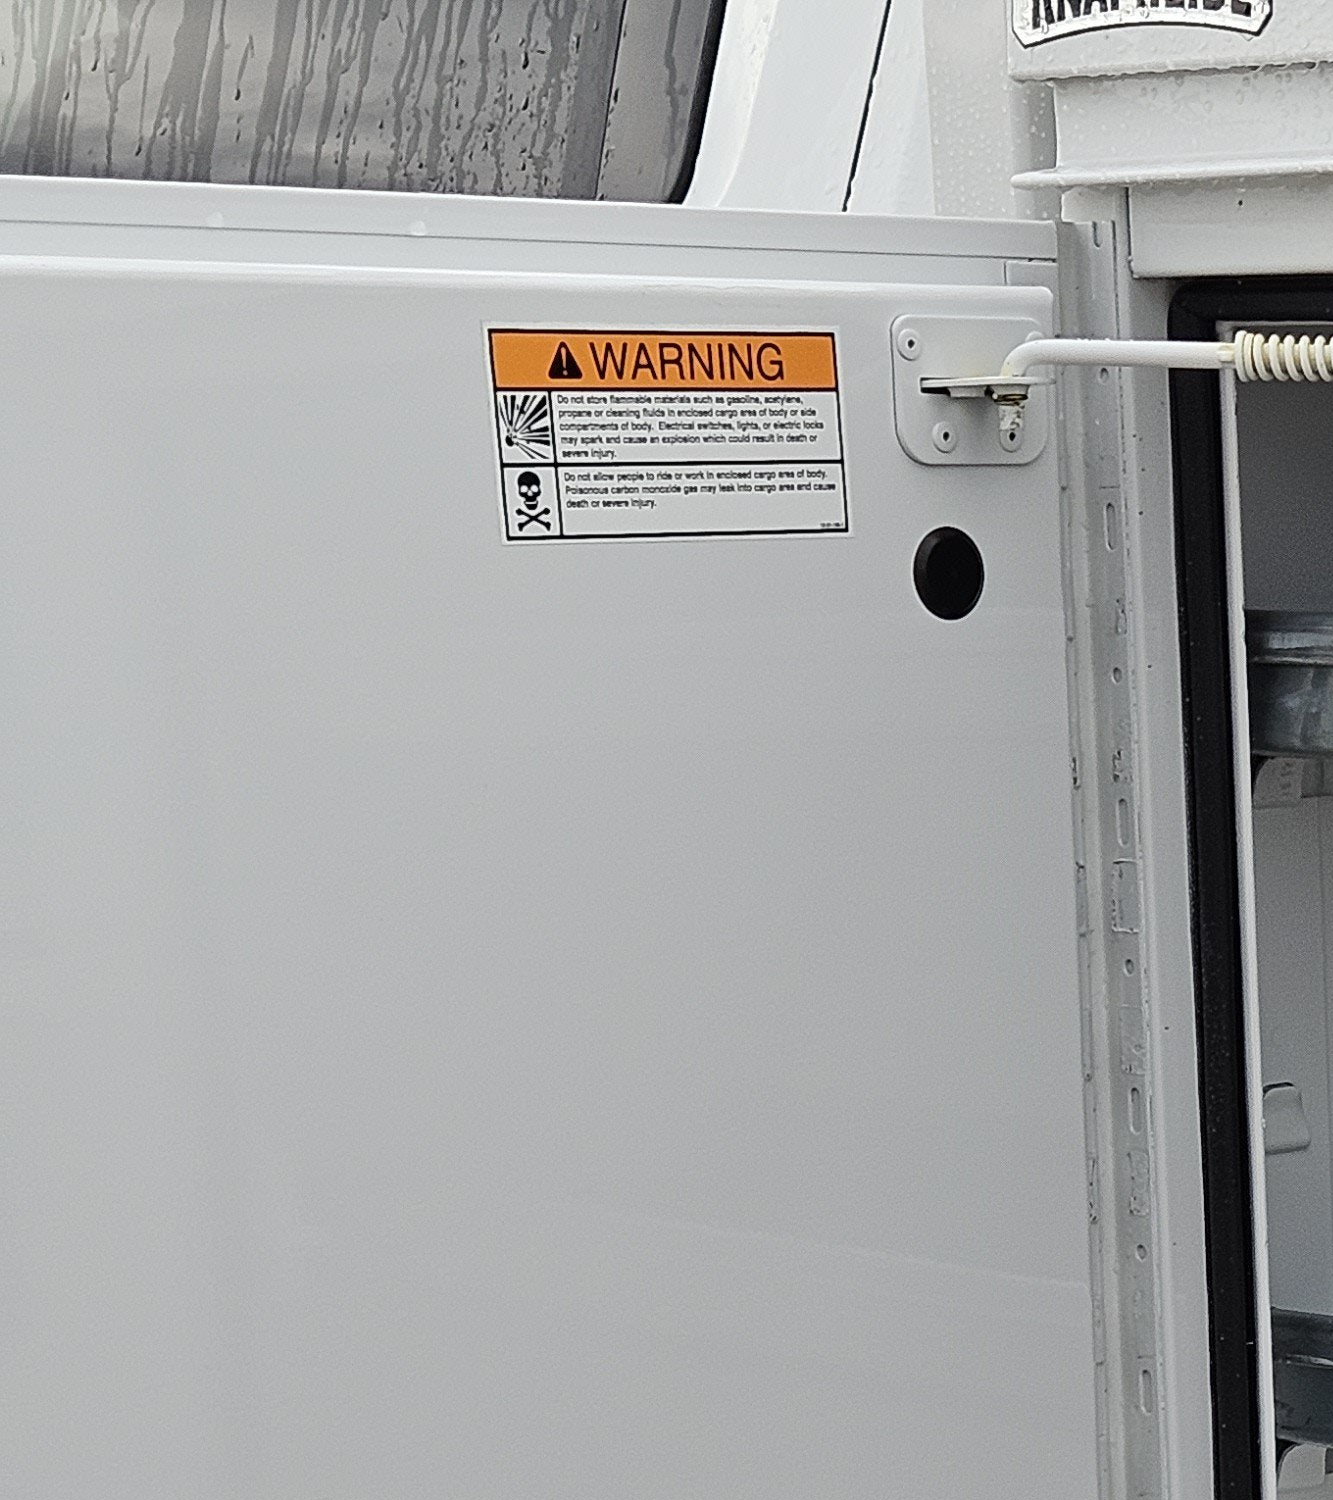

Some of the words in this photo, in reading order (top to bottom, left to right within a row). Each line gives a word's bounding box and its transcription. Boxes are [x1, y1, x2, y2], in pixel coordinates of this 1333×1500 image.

[589, 342, 784, 380] WARNING
[557, 395, 569, 404] Do
[570, 395, 584, 404] not
[586, 396, 607, 404] store
[610, 395, 652, 404] flammable
[654, 395, 690, 404] materials
[694, 395, 713, 404] such
[727, 395, 762, 406] gasoline,
[764, 396, 804, 405] acetylene,
[558, 410, 592, 419] propane
[606, 409, 640, 419] cleaning
[643, 408, 665, 417] fluids
[677, 408, 713, 416] enclosed
[715, 409, 738, 418] cargo
[759, 408, 767, 416] of
[769, 408, 788, 418] body
[800, 408, 816, 416] side
[559, 423, 619, 432] compartments
[621, 421, 629, 430] of
[631, 422, 654, 432] body.
[658, 421, 694, 430] Electrical
[697, 422, 735, 430] switches,
[737, 421, 761, 432] lights,
[773, 421, 801, 429] electric
[803, 421, 824, 429] locks
[561, 437, 578, 446] may
[580, 435, 603, 446] spark
[605, 435, 620, 444] and
[662, 435, 700, 445] explosion
[702, 434, 726, 443] which
[728, 434, 750, 442] could
[752, 434, 775, 442] result
[777, 434, 784, 442] in
[786, 434, 807, 442] death
[562, 450, 589, 458] severe
[591, 449, 617, 459] injury.
[564, 472, 575, 482] Do
[577, 472, 590, 481] not
[593, 472, 614, 481] allow
[617, 472, 644, 482] people
[646, 472, 654, 480] to
[656, 472, 672, 480] ride
[685, 470, 704, 480] work
[707, 470, 714, 479] in
[716, 470, 752, 479] enclosed
[754, 472, 776, 481] cargo
[797, 469, 805, 478] of
[806, 470, 828, 480] body.
[565, 486, 609, 494] Poisonous
[610, 486, 639, 494] carbon
[642, 485, 681, 493] monoxide
[684, 486, 698, 495] gas
[700, 485, 717, 494] may
[719, 483, 735, 492] leak
[737, 483, 752, 492] into
[754, 484, 776, 494] cargo
[797, 483, 811, 491] and
[813, 483, 836, 491] cause
[566, 499, 589, 508] death
[631, 499, 657, 509] injury.
